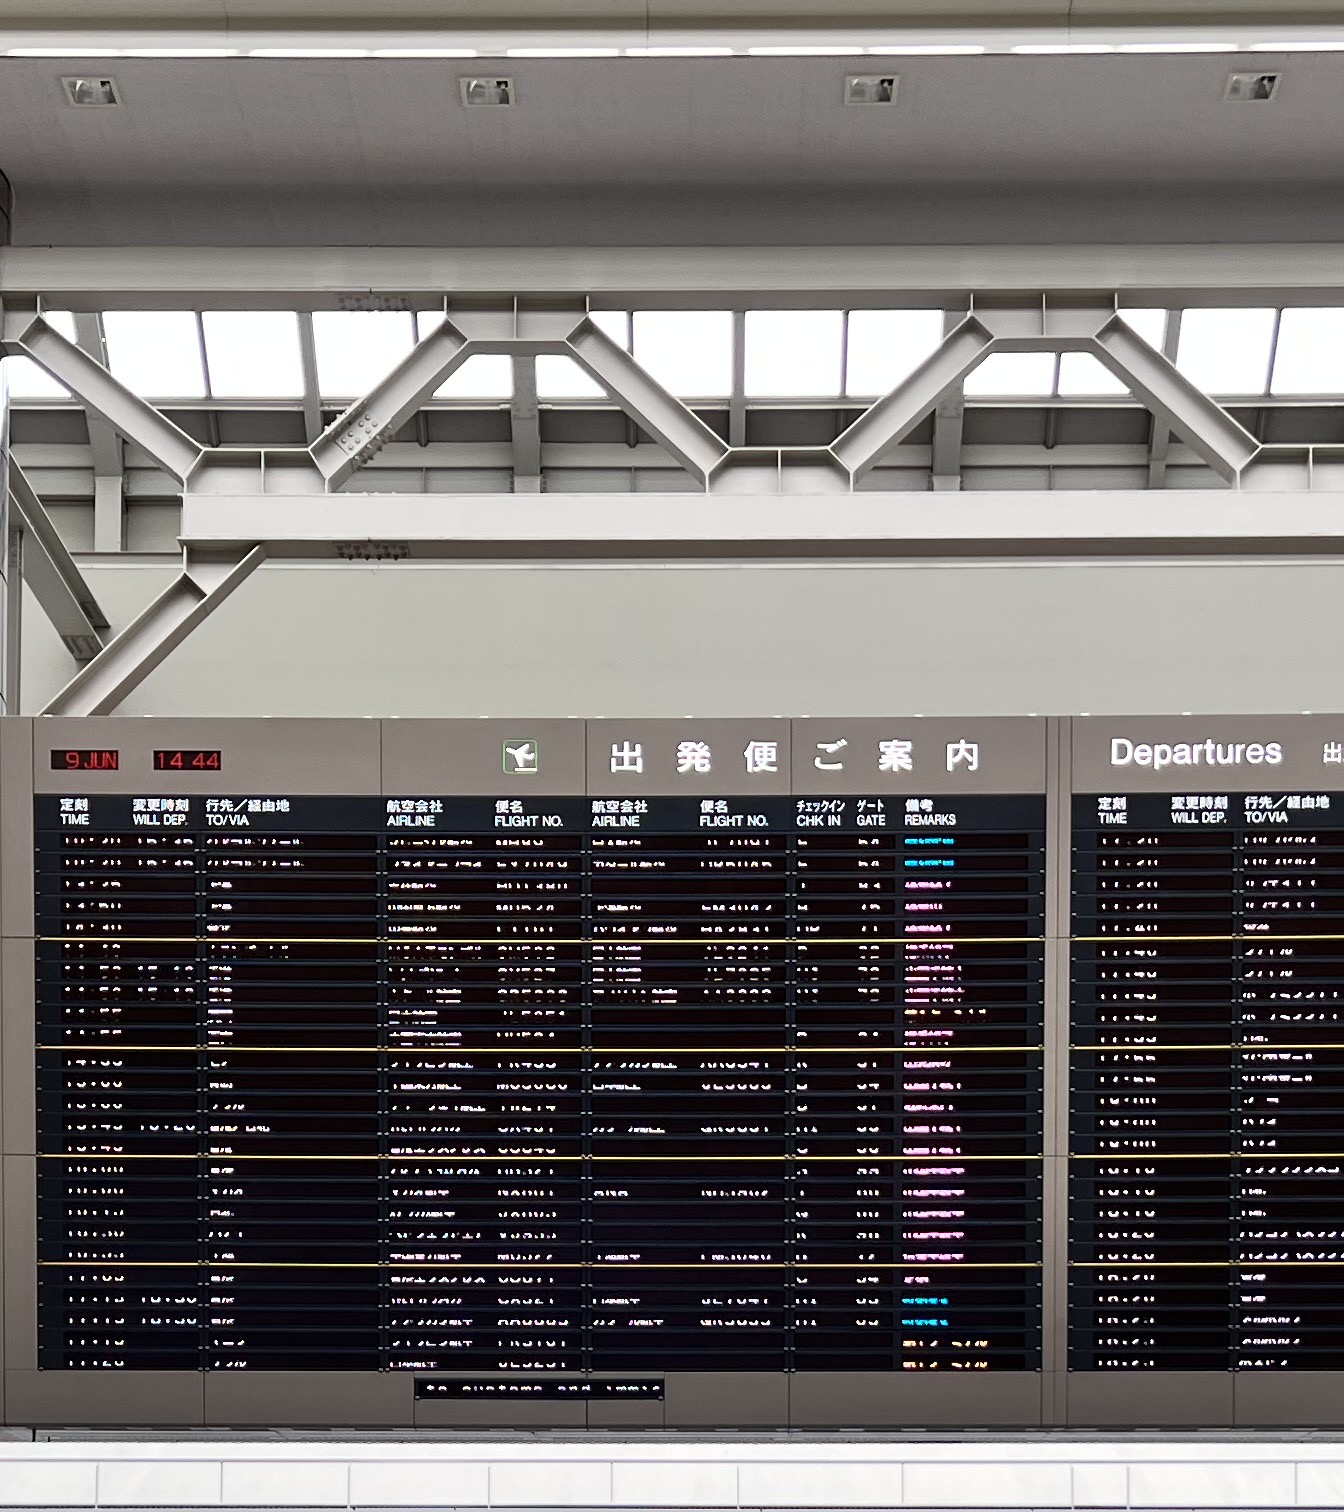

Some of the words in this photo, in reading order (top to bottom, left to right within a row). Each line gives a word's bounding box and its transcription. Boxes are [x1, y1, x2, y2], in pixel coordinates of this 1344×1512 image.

[609, 738, 980, 774] 出発便ご案内
[1109, 738, 1283, 770] Departures
[65, 752, 80, 769] 9
[84, 752, 117, 769] JUN
[60, 798, 88, 812] 定刻
[133, 798, 189, 812] 変更時刻
[206, 798, 290, 812] 行先／経由地
[387, 799, 443, 813] 航空会社
[495, 800, 523, 813] 便名
[592, 800, 648, 813] 航空会社
[700, 800, 728, 813] 便名
[796, 800, 845, 812] チェックイン
[856, 800, 884, 812] ゲート
[1097, 797, 1126, 810] 定刻
[1171, 796, 1228, 809] 変更時刻
[1244, 796, 1330, 809] 行先／経由地
[60, 814, 89, 826] TIME
[133, 814, 160, 826] WILL
[164, 814, 189, 826] DEP.
[206, 814, 249, 826] TO/VIA
[387, 815, 435, 827] AIRLINE
[495, 815, 538, 827] FLIGHT
[542, 815, 564, 827] NO.
[592, 815, 640, 827] AIRLINE
[700, 815, 743, 827] FLIGHT
[747, 815, 768, 827] NO.
[797, 815, 825, 827] CHK
[828, 815, 841, 827] IN
[857, 814, 886, 827] GATE
[905, 814, 956, 826] REMARKS
[1098, 812, 1127, 824] TIME
[1171, 811, 1199, 823] WILL
[1201, 811, 1227, 823] DEP.
[1244, 811, 1288, 823] TO/VIA
